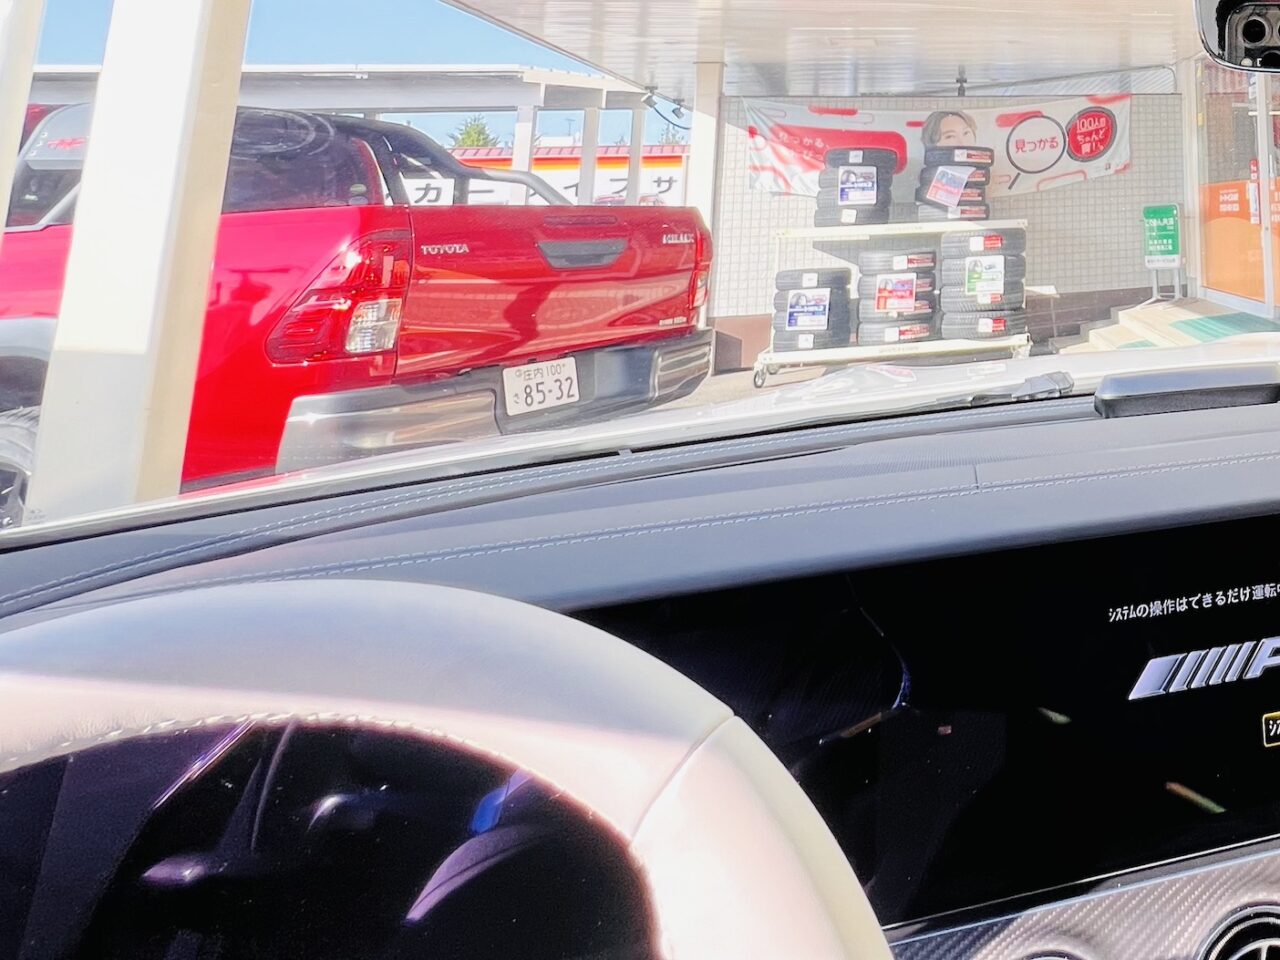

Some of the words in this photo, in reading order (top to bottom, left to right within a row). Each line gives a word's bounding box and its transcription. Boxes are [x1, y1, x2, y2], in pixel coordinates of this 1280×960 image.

[1015, 136, 1059, 154] 見つかる
[420, 243, 470, 255] TOYOTA
[524, 376, 576, 407] 85-32
